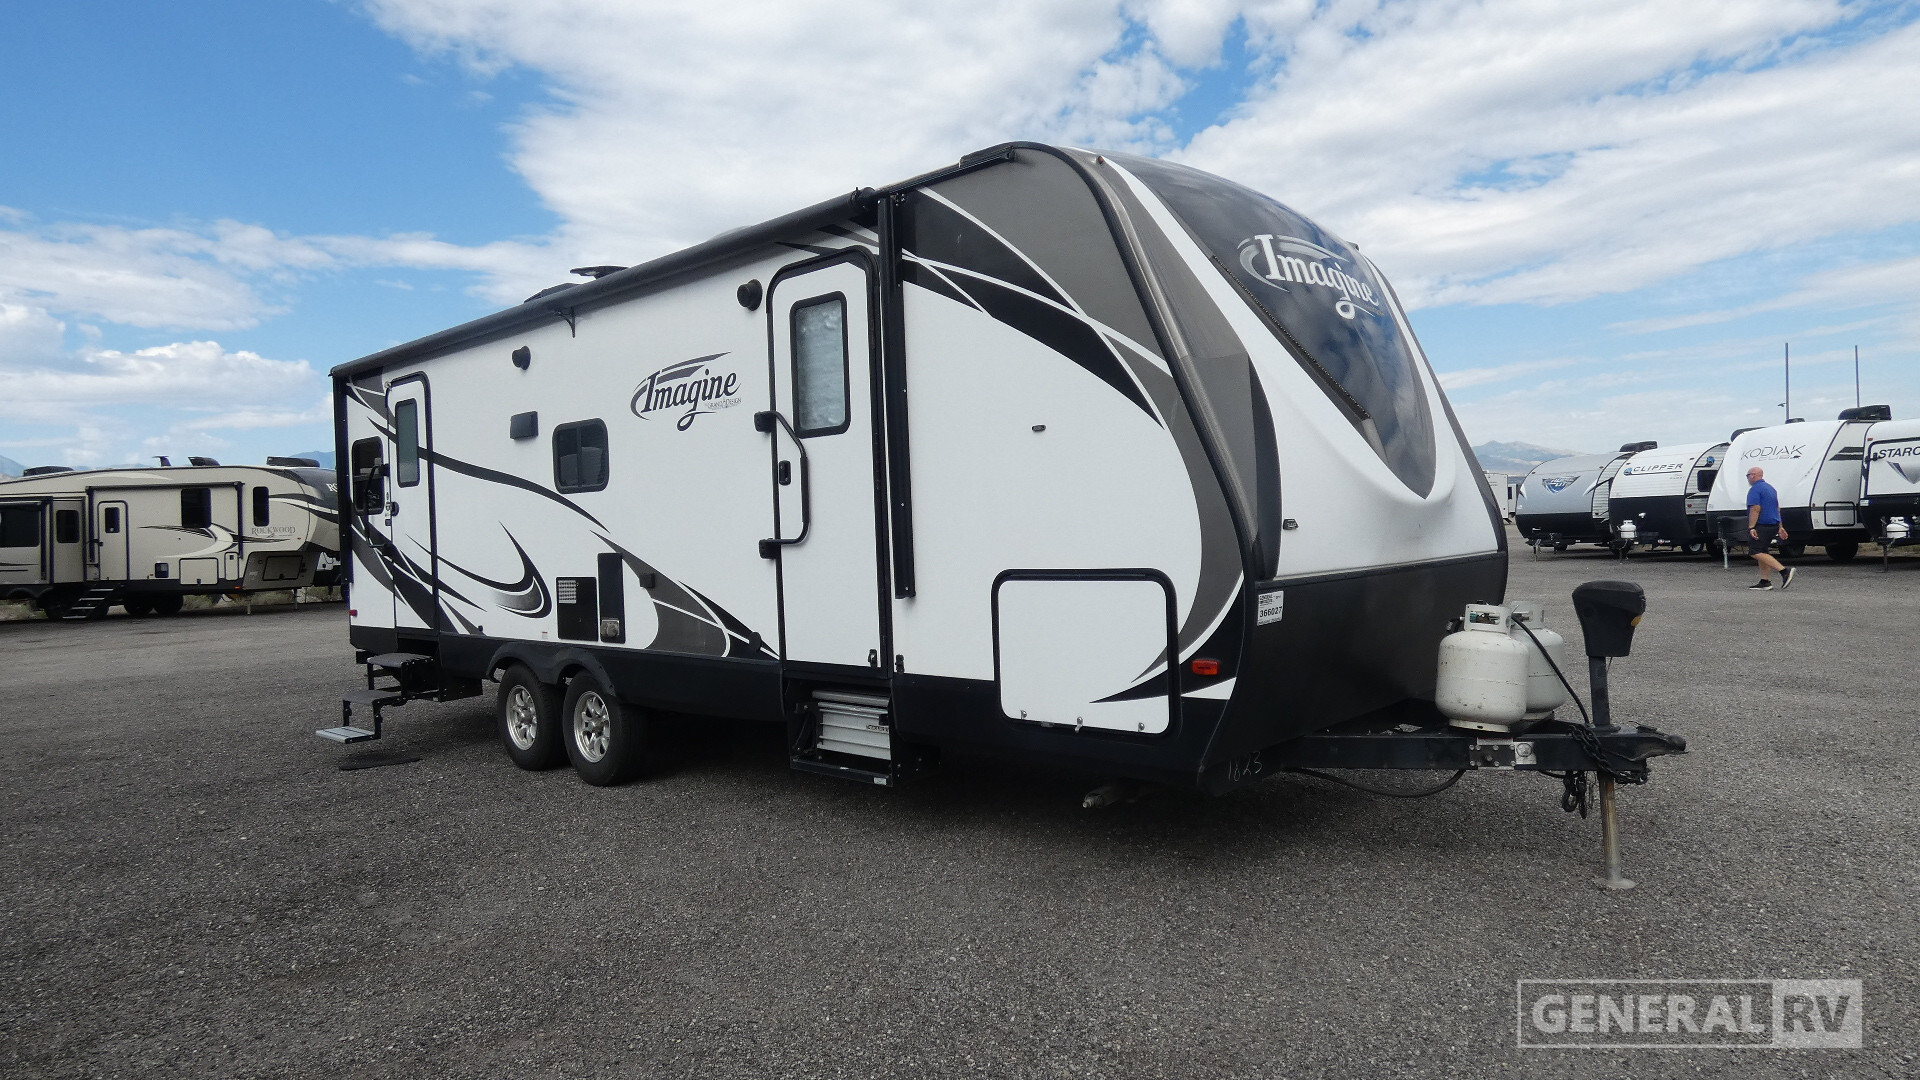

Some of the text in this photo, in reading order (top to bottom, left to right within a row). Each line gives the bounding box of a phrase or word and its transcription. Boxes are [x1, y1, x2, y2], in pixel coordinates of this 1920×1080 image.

[1254, 234, 1380, 320] Imagine
[640, 368, 742, 432] Imagine
[1740, 444, 1806, 460] KODIAK
[1633, 463, 1684, 472] CLIPPER
[251, 526, 296, 537] ROCKWOOD
[1259, 606, 1283, 618] 366027
